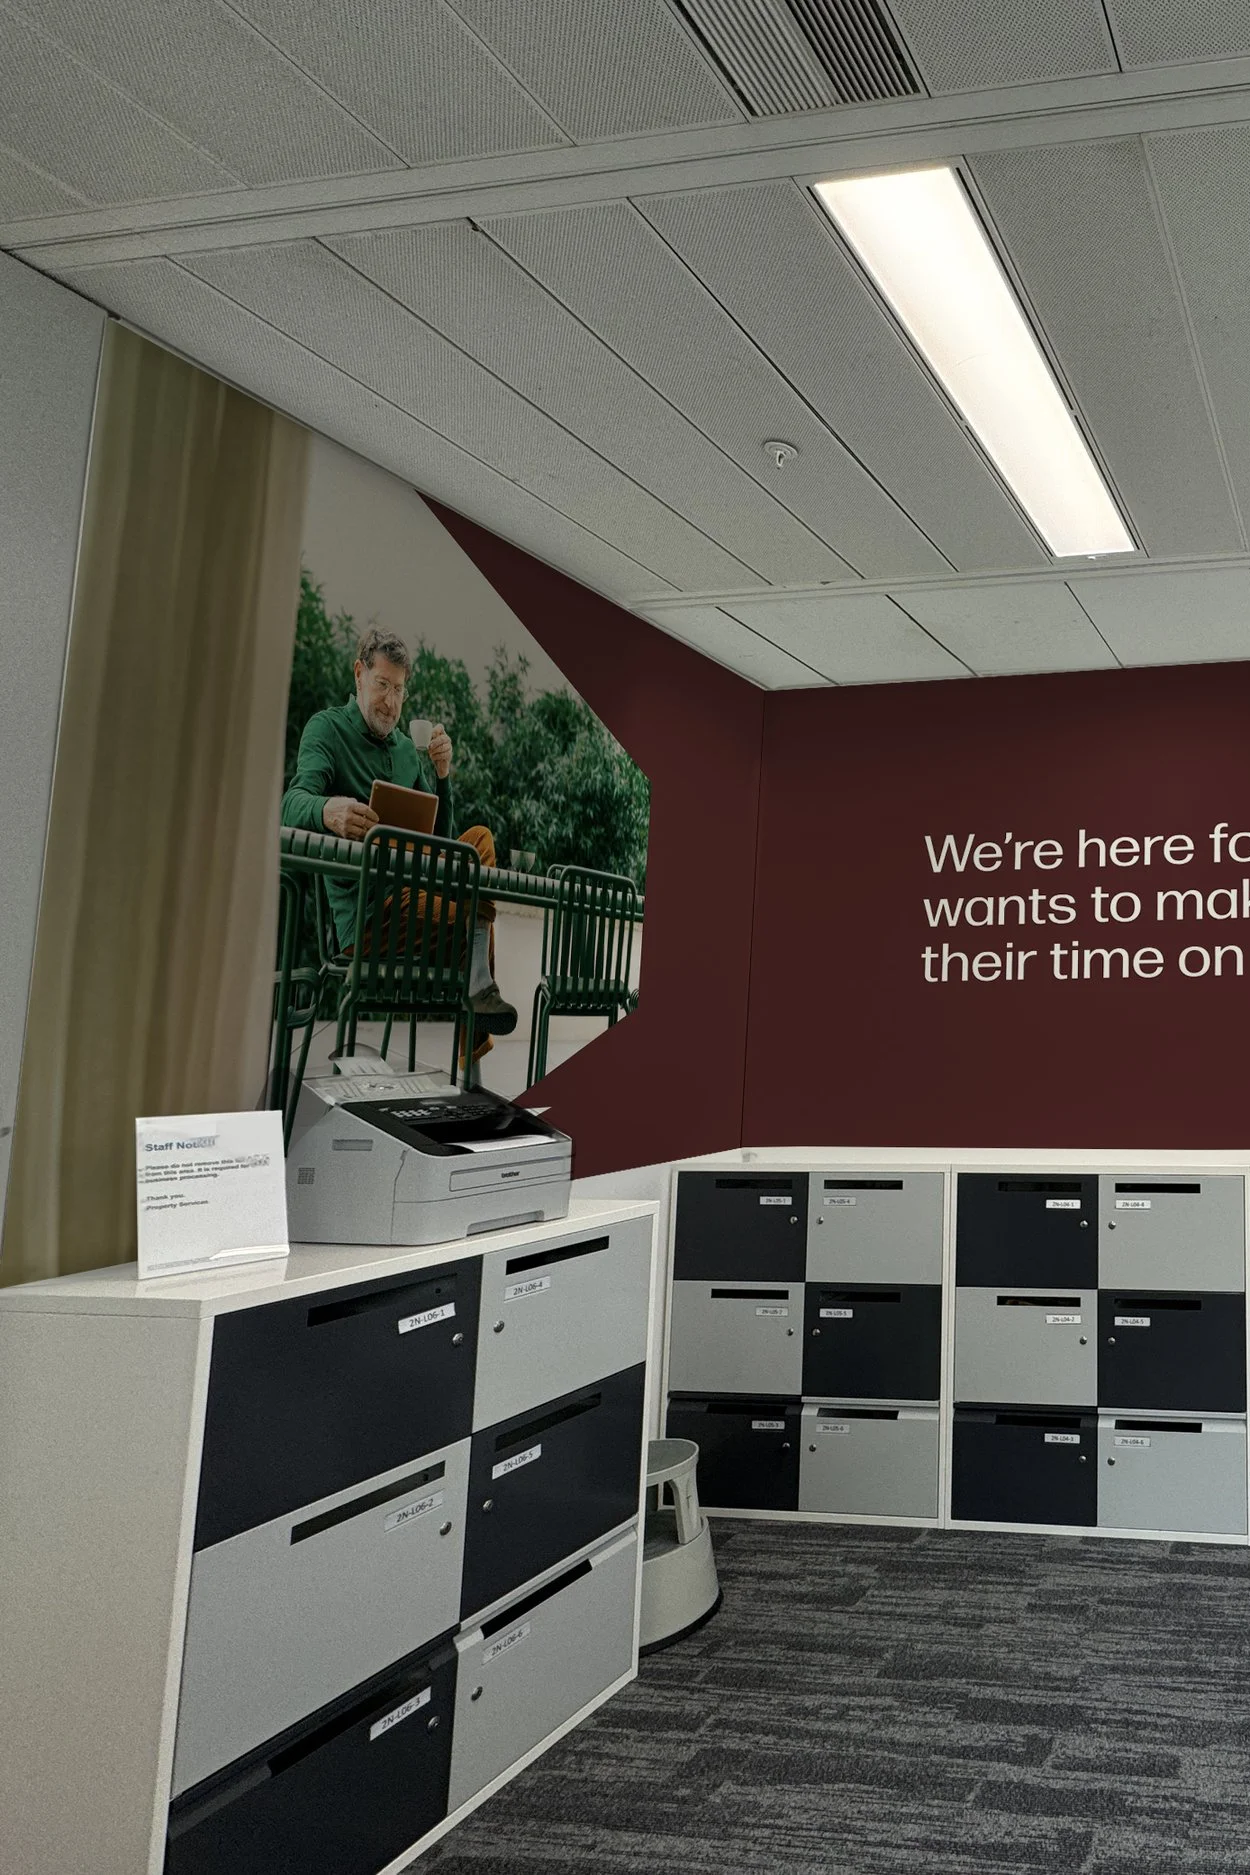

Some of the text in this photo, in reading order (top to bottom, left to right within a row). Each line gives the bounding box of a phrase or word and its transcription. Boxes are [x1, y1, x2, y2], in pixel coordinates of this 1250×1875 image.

[1078, 828, 1195, 868] here
[923, 888, 1077, 928] wants
[1090, 886, 1142, 923] to
[920, 942, 1038, 983] their
[1049, 940, 1165, 980] time
[1178, 944, 1244, 978] on
[145, 1138, 215, 1152] Staff Not
[513, 1281, 543, 1295] 2N-L06-4
[409, 1309, 445, 1328] 2N-L06-1
[503, 1451, 533, 1472] 2N-L06-5
[396, 1498, 434, 1523] 2N-L06-2
[491, 1629, 523, 1656] 2N-L06-6
[381, 1697, 421, 1729] 2N-L06-3
